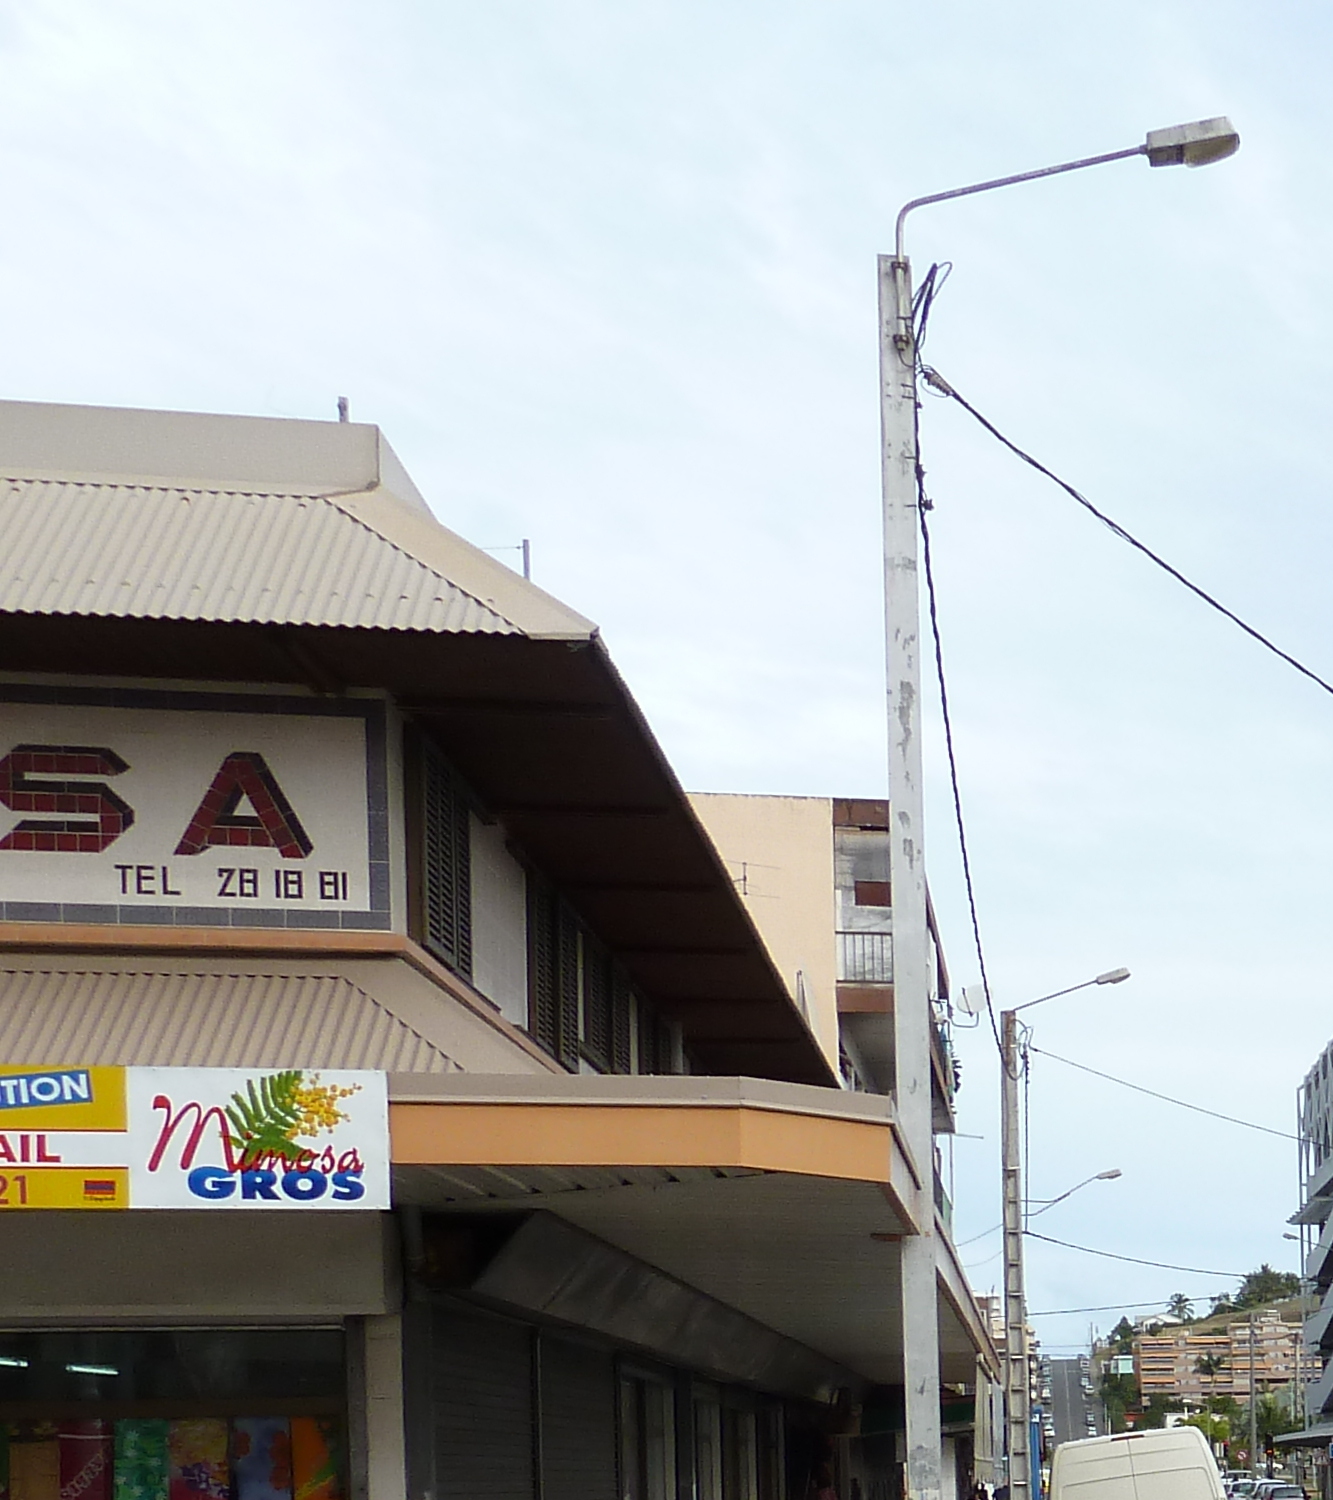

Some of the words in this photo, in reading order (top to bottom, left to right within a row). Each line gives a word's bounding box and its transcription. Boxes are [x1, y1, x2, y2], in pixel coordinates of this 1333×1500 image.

[0, 743, 313, 859] SA
[114, 864, 182, 896] TEL
[217, 867, 260, 898] 28
[274, 869, 304, 899] 18
[319, 870, 349, 901] 81
[0, 1073, 89, 1105] TION
[147, 1094, 364, 1175] Mimosa
[187, 1165, 366, 1201] GROS
